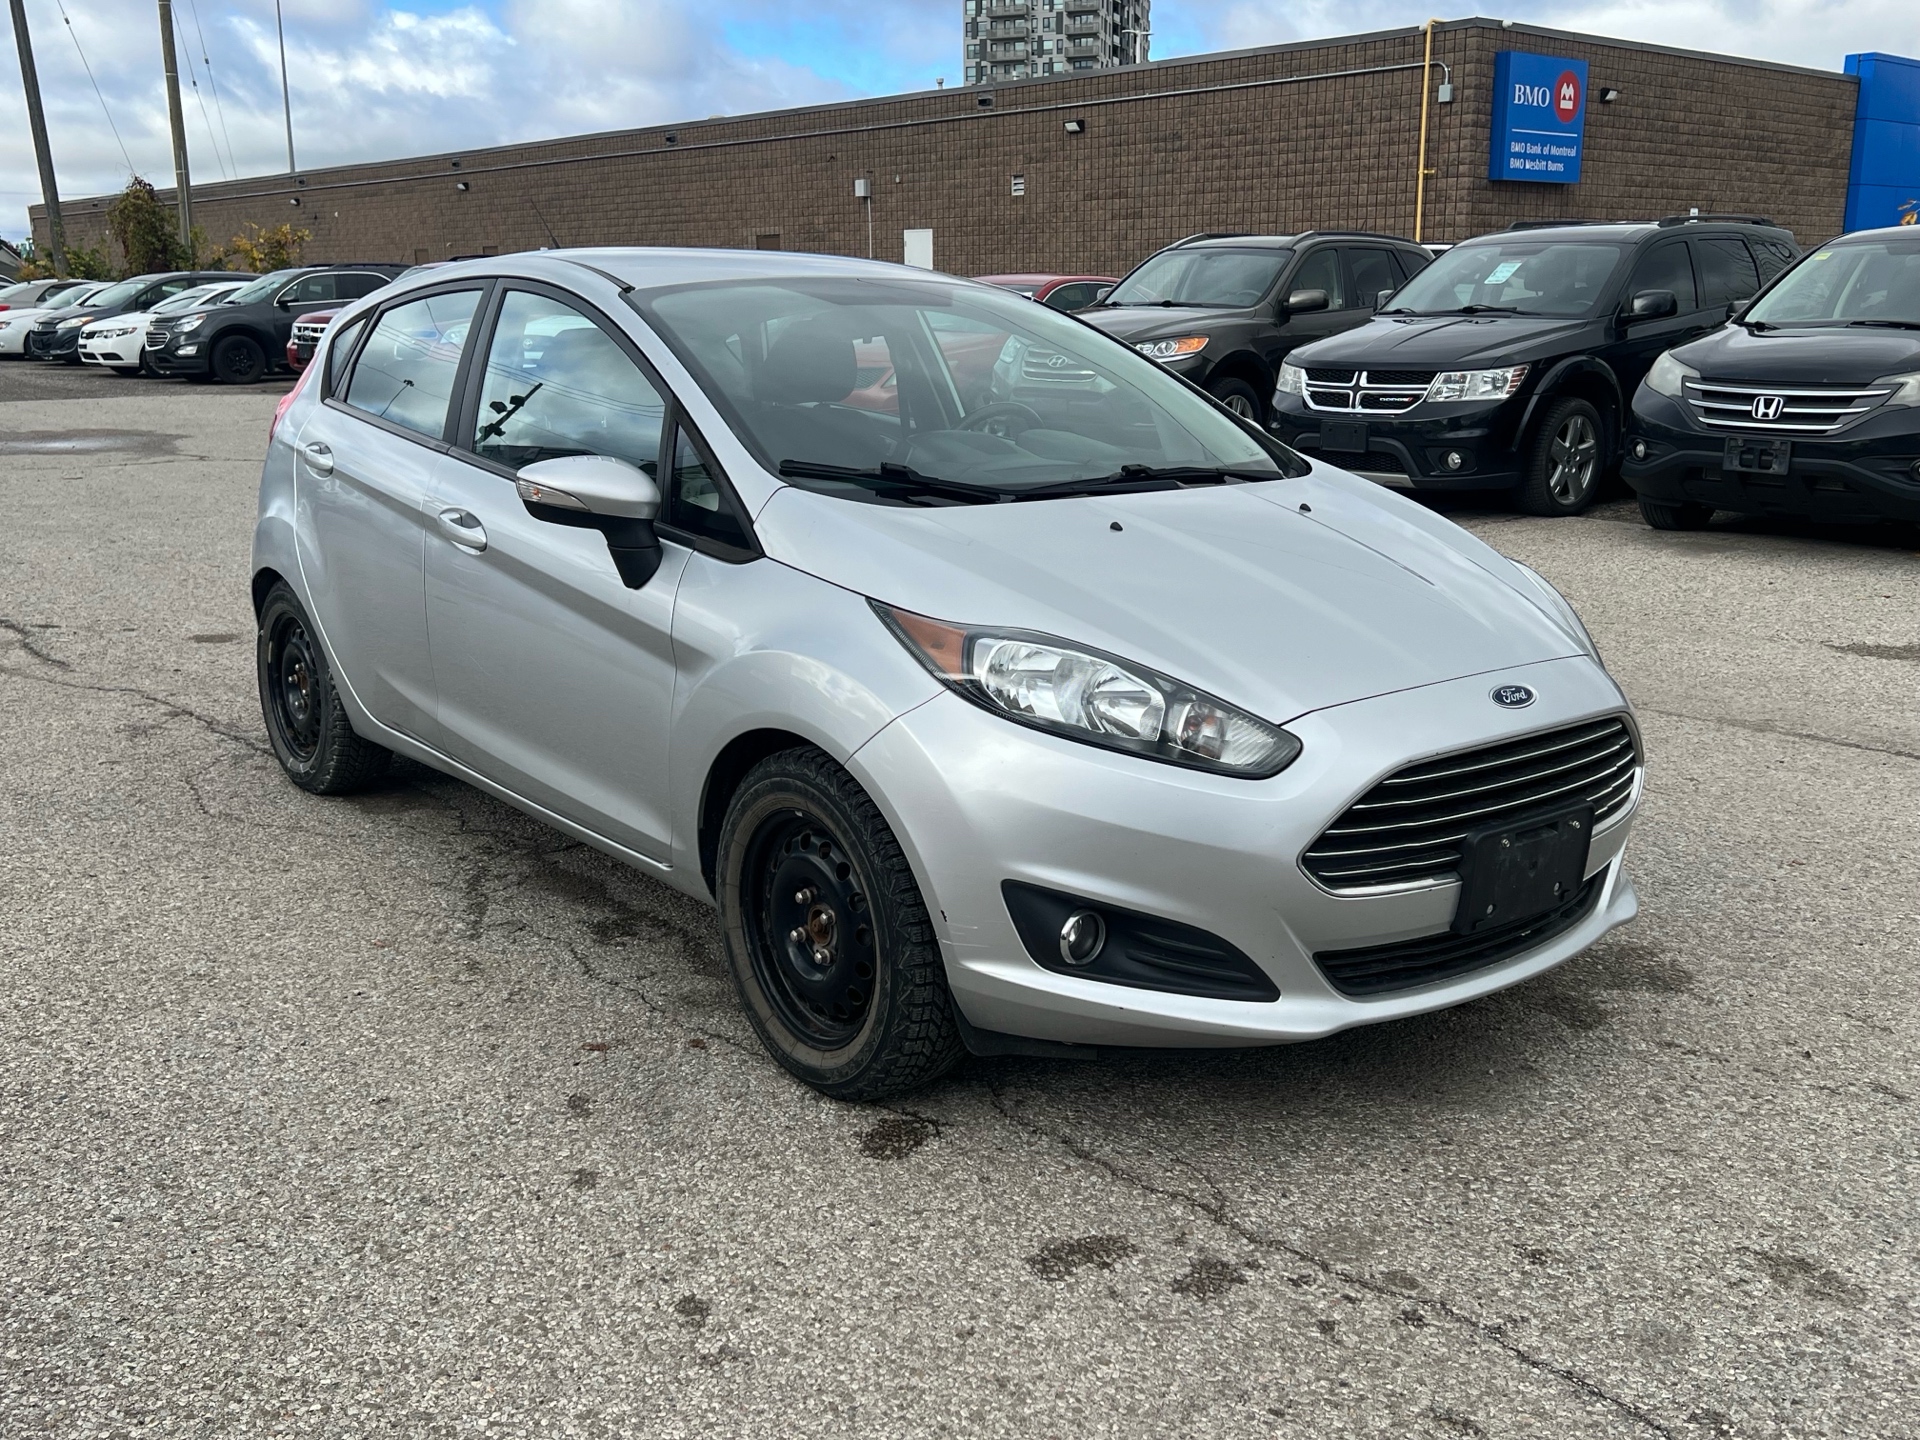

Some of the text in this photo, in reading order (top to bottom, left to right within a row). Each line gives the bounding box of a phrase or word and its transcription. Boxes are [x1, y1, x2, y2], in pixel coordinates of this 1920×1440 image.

[1513, 84, 1550, 107] BMO
[1511, 141, 1577, 157] BMO Bank of Montreal
[1510, 158, 1564, 171] BMO Nesbitt Burns
[1500, 687, 1528, 703] Ford
